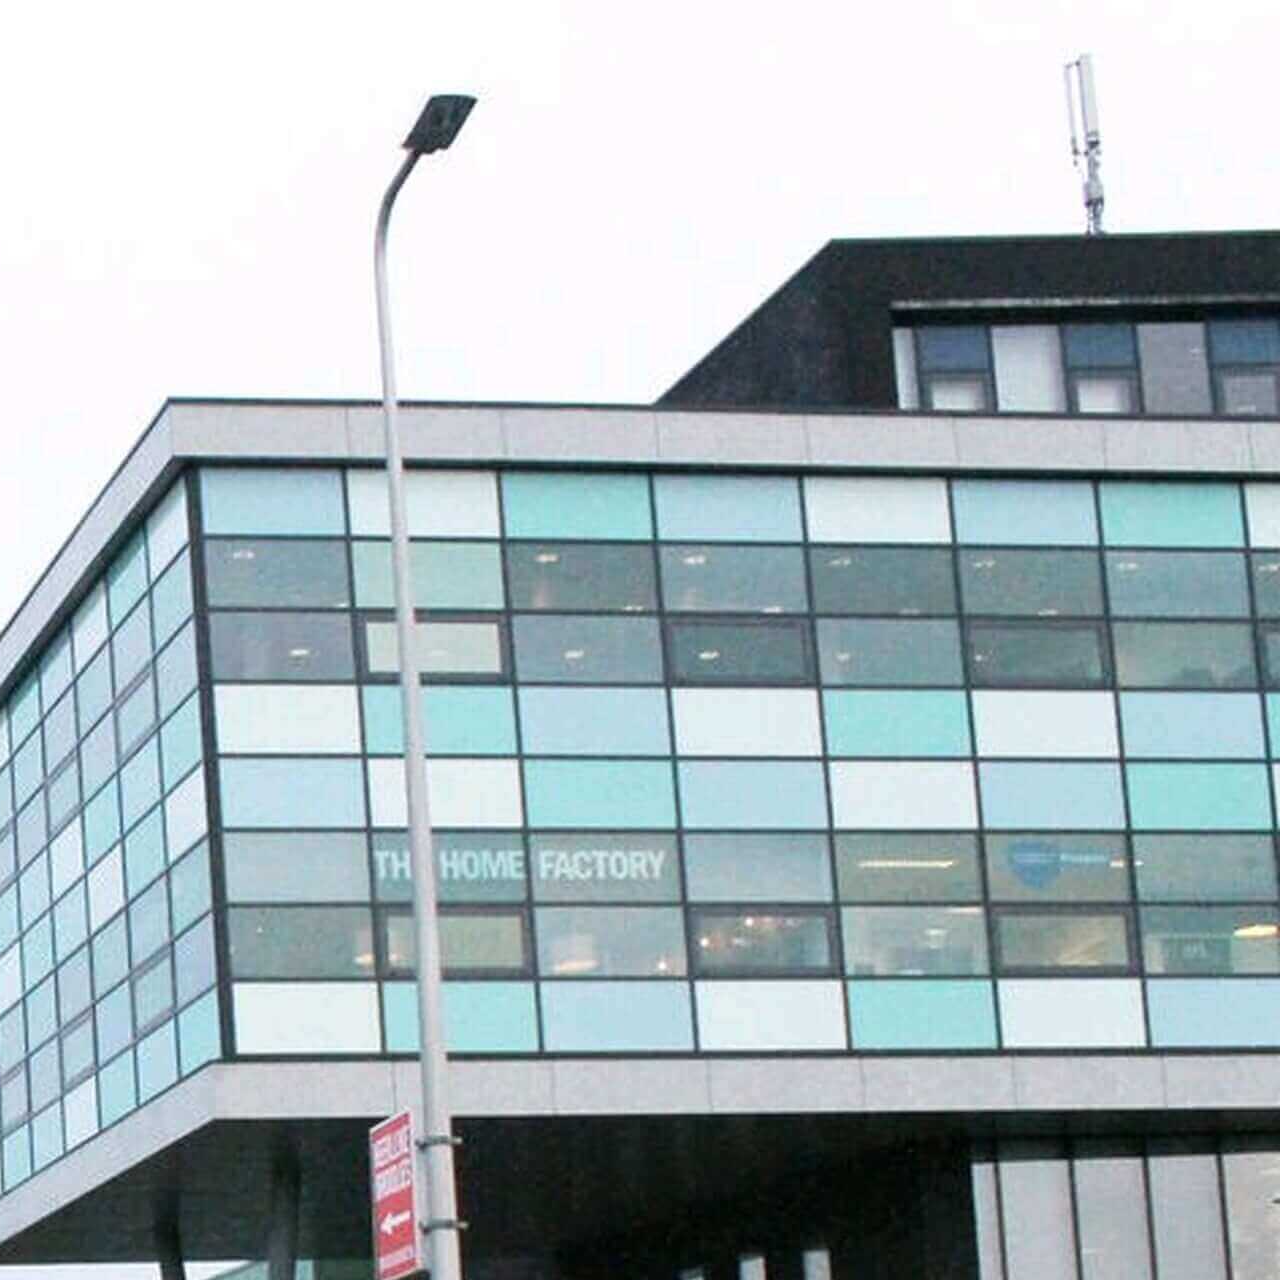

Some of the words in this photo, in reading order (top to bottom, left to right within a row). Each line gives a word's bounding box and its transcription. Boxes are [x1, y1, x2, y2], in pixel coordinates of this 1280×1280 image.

[373, 849, 413, 879] TH
[440, 849, 527, 879] HOME
[539, 849, 666, 880] FACTORY
